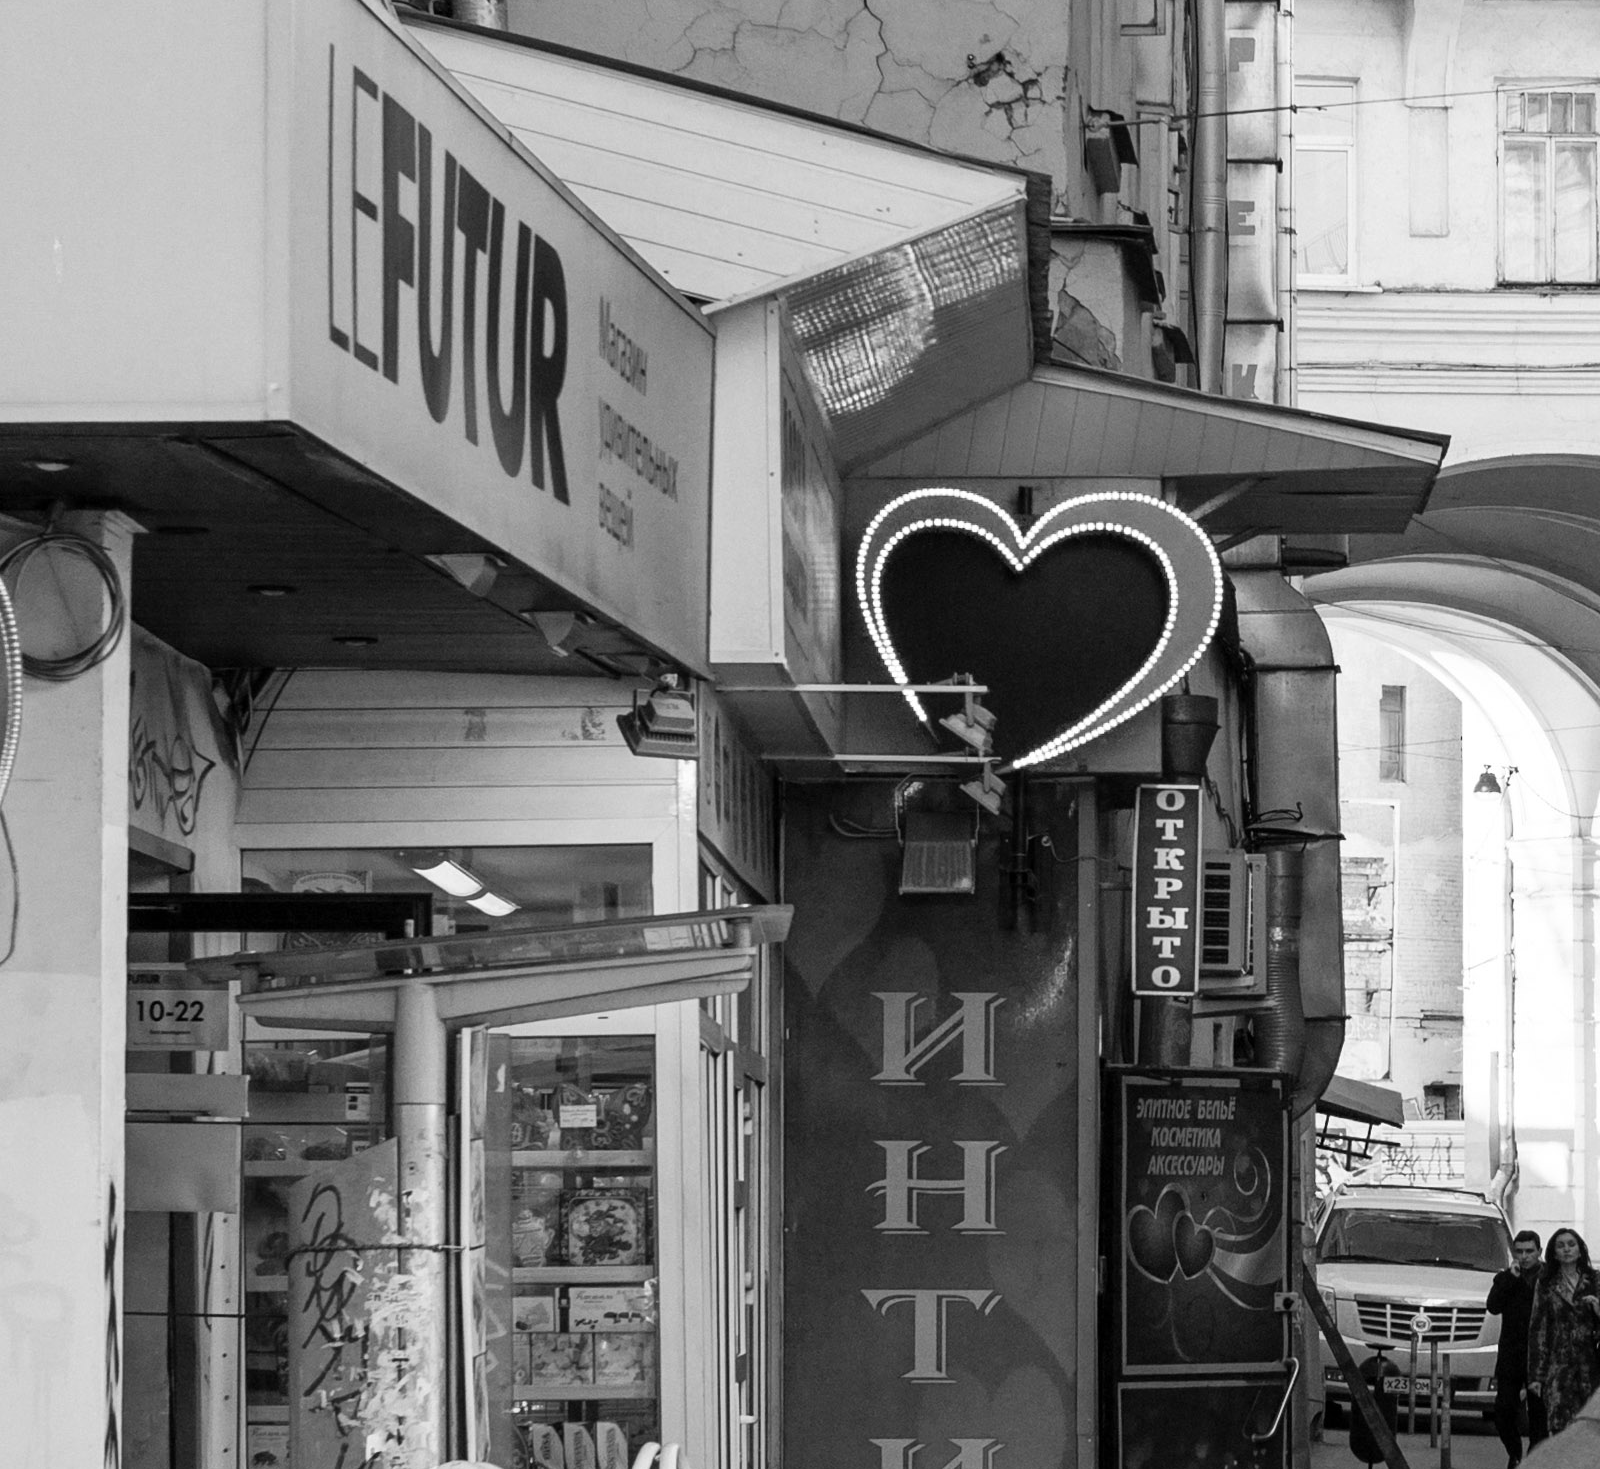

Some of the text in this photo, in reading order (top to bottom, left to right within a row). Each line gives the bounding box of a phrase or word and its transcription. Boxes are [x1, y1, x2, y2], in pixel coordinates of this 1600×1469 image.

[1146, 789, 1189, 988] ОТКРЫТО
[137, 1000, 204, 1022] 10-22
[1136, 1097, 1236, 1120] ЭЛИТНОЕ БЕЛЬЁ
[1151, 1127, 1221, 1147] КОСМЕТИКА
[1147, 1155, 1225, 1175] АКСЕССУАРЫ
